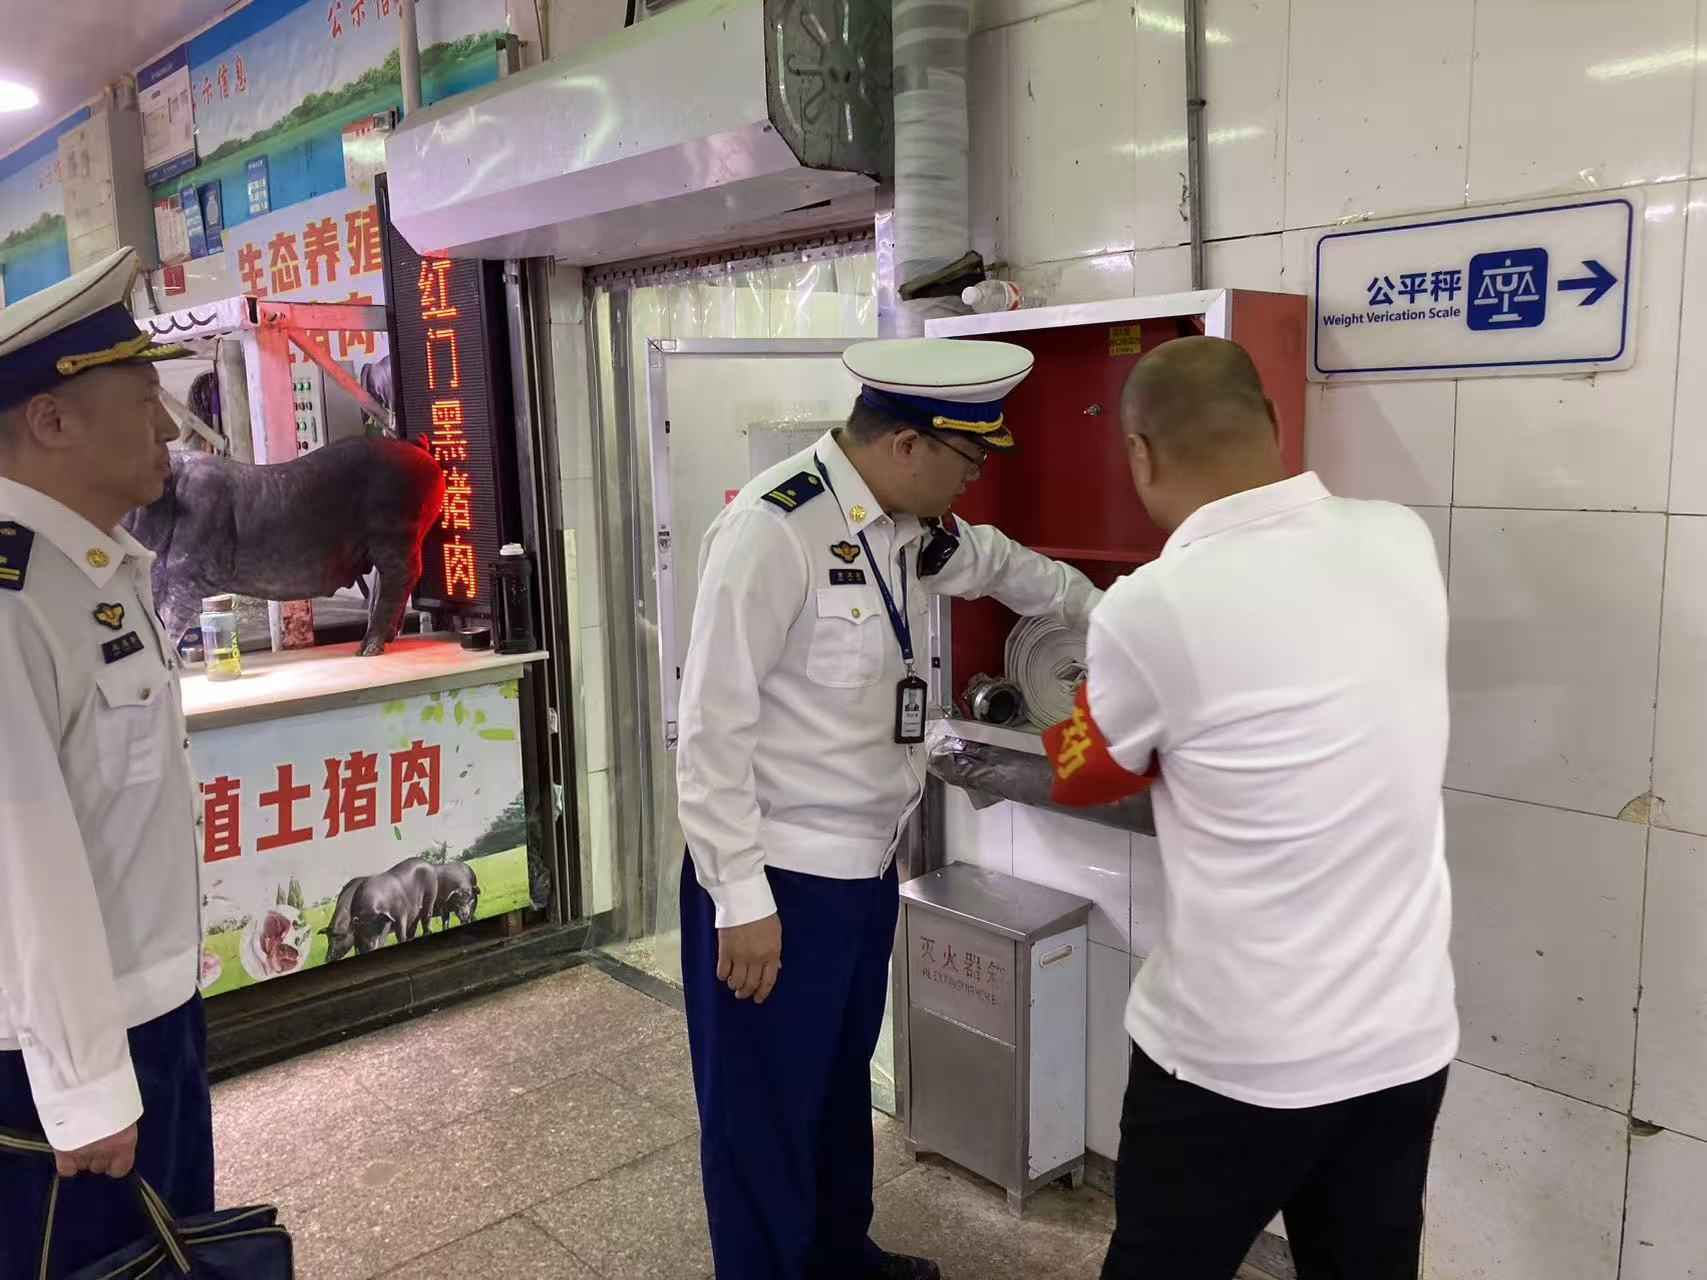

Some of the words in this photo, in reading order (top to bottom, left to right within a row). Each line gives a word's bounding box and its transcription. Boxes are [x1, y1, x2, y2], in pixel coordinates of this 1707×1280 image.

[193, 55, 248, 104] 示信息
[238, 204, 383, 298] 生态养殖
[1366, 270, 1461, 306] 公平秤
[1323, 312, 1364, 328] Weight
[1366, 308, 1426, 323] Verication
[1428, 306, 1461, 319] Scale
[418, 258, 477, 599] 红门黑猪肉
